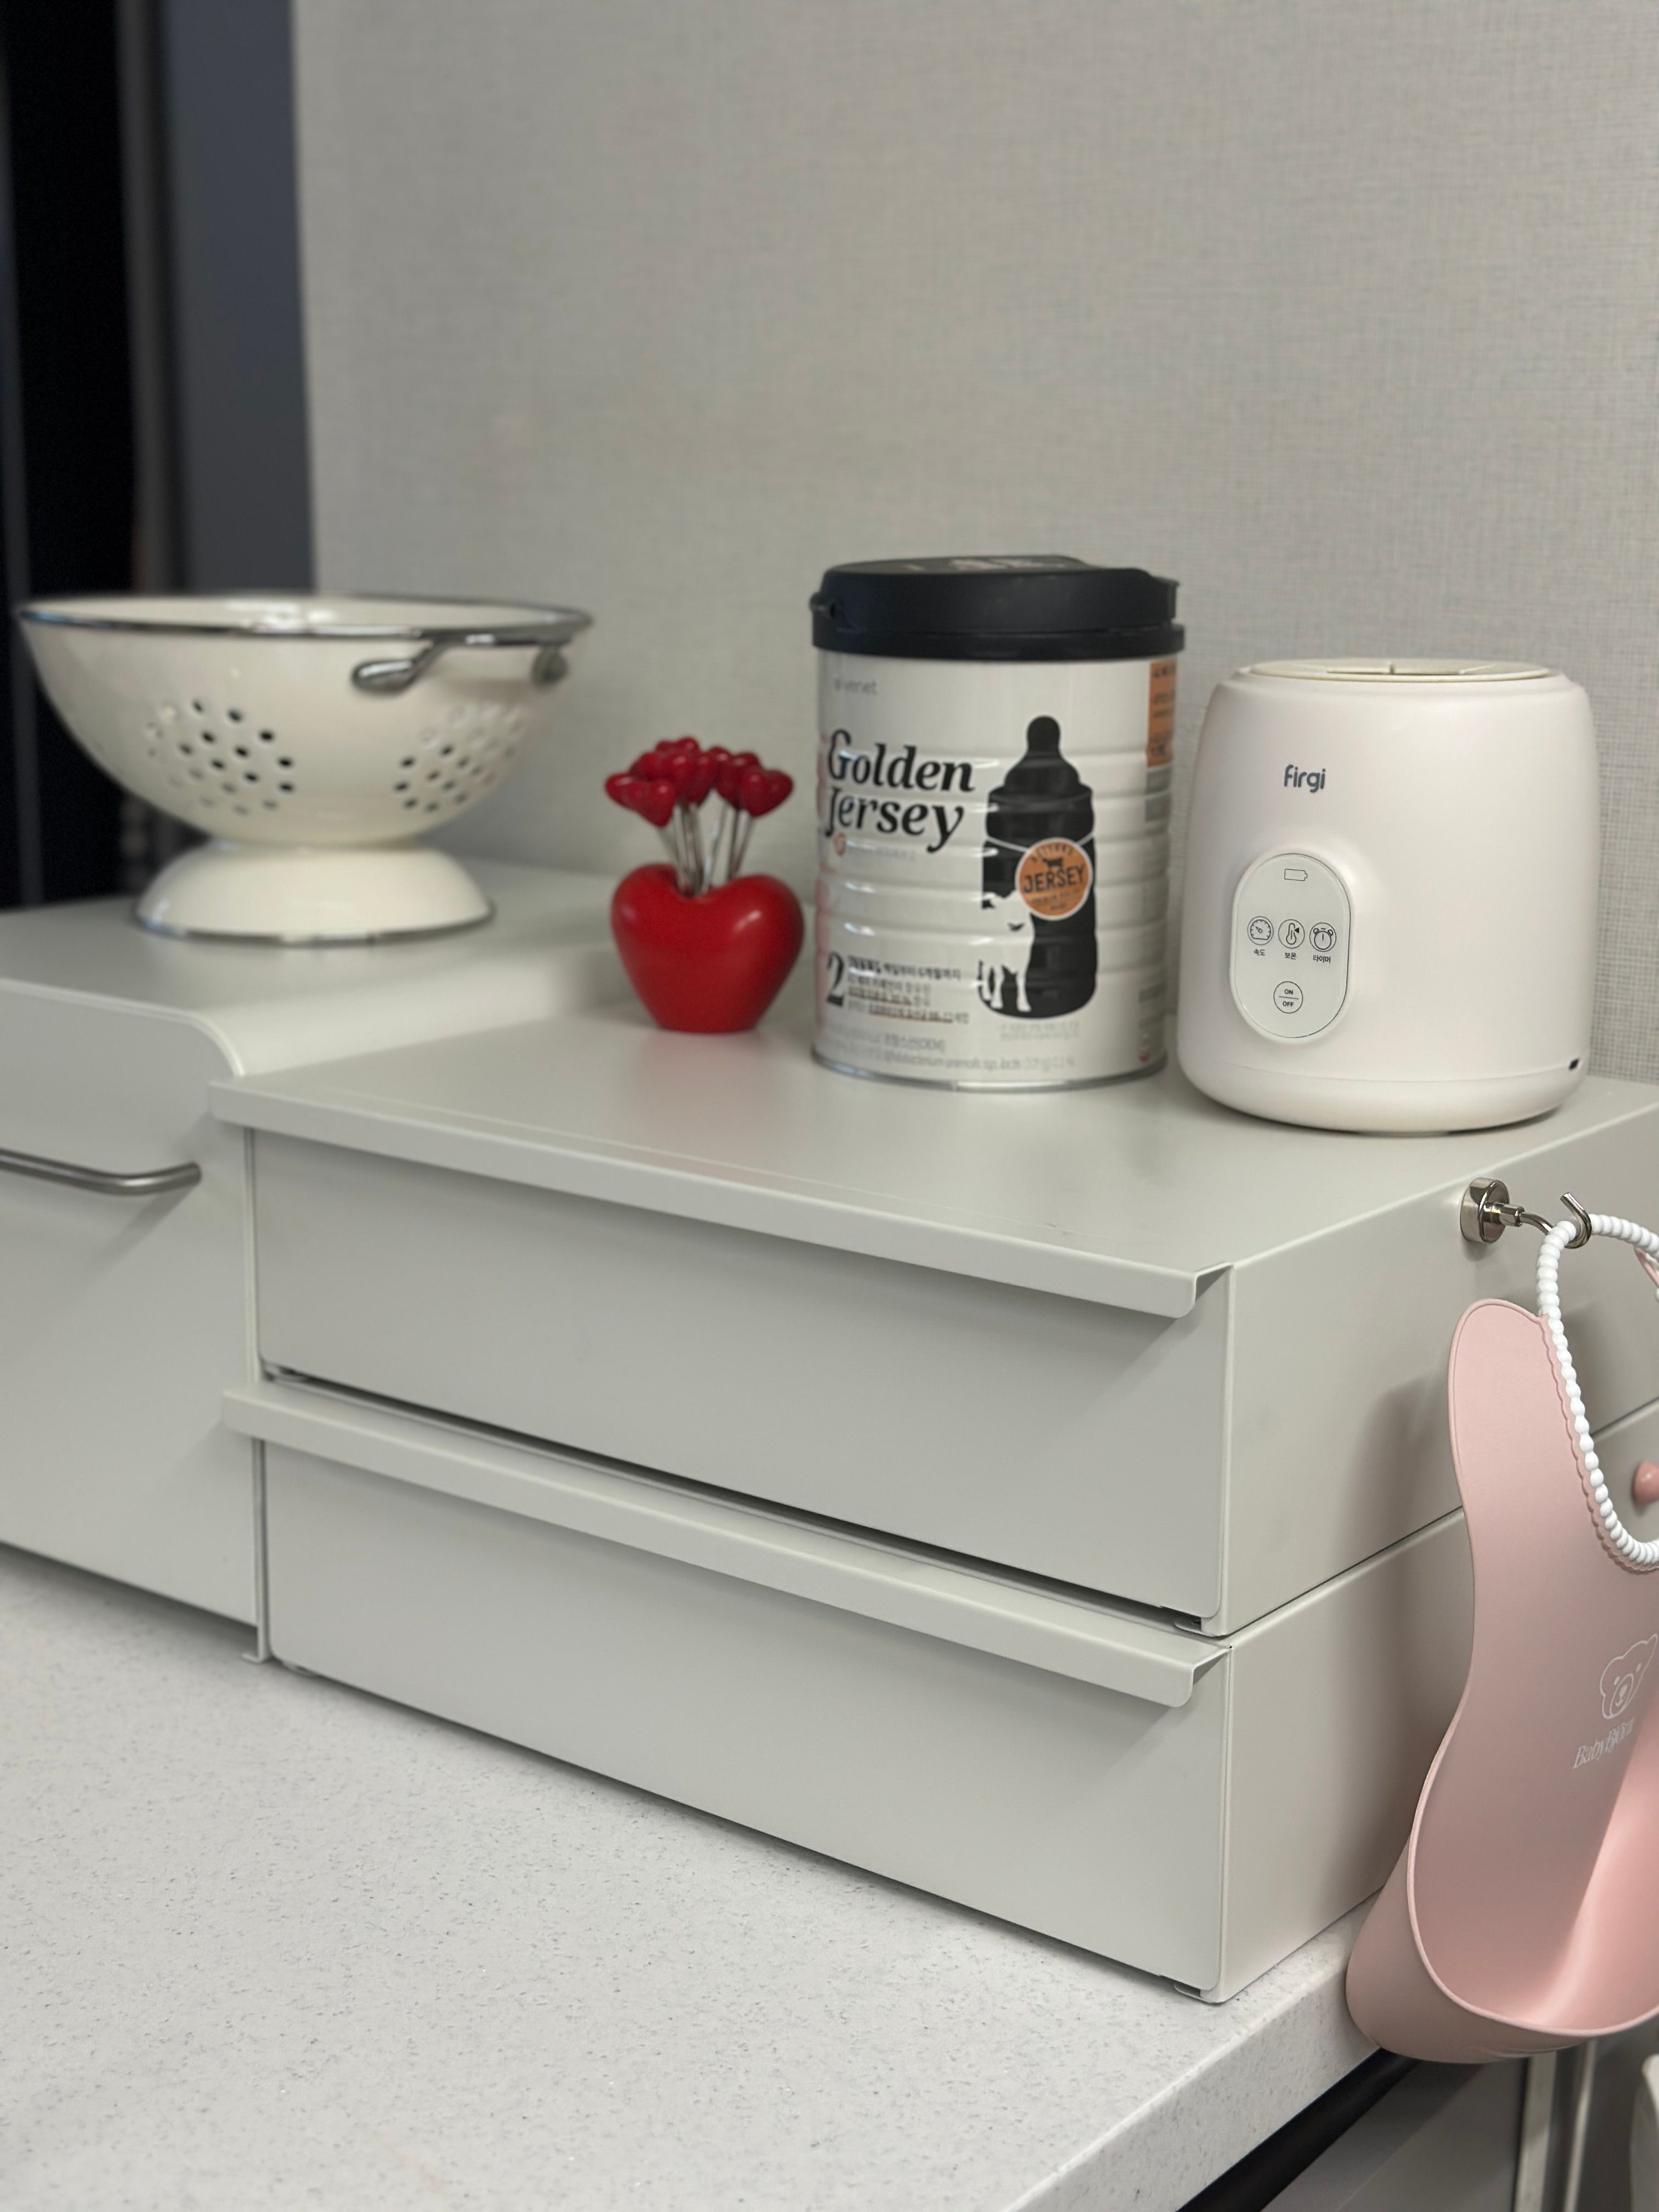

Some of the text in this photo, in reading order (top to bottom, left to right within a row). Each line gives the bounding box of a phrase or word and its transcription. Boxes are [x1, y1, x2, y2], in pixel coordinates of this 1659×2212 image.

[828, 728, 975, 792] Golden
[1284, 764, 1326, 793] firgi
[825, 787, 965, 854] Jersey
[1023, 865, 1085, 893] JERSEY
[826, 951, 845, 1008] 2
[1312, 955, 1332, 964] 타이머
